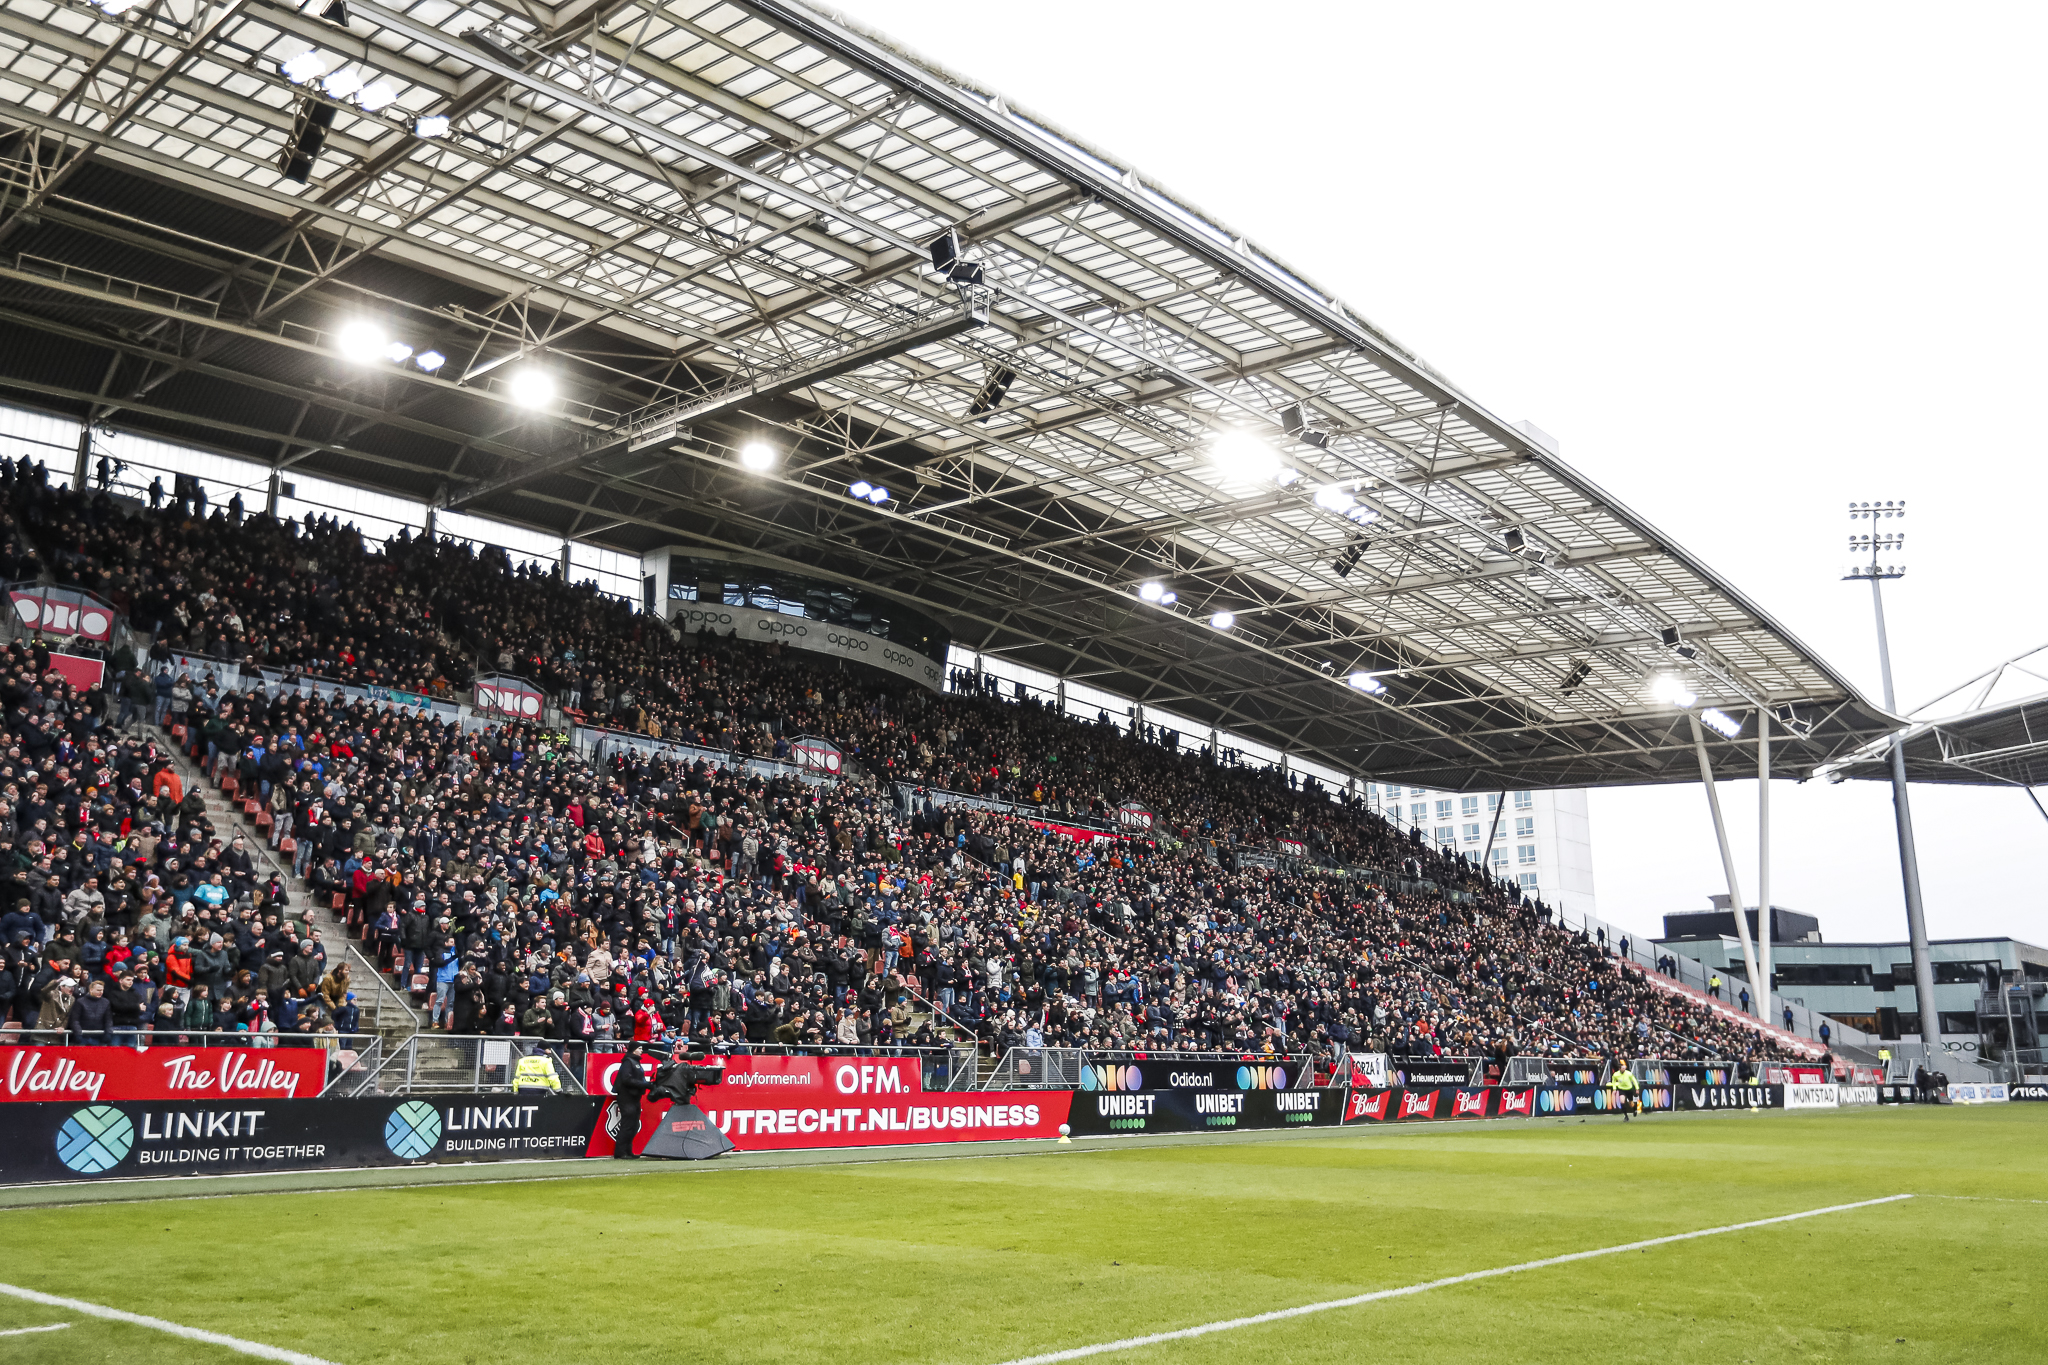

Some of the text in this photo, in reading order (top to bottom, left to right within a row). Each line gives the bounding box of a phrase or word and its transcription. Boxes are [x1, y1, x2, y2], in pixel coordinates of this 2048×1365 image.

[758, 619, 808, 637] oppo
[827, 633, 869, 651] oppo
[883, 648, 914, 667] oppo
[9, 1050, 106, 1101] Valley
[163, 1051, 300, 1099] The Valley
[1352, 1060, 1376, 1075] FORZA
[727, 1071, 811, 1088] onlyformen.nl
[1170, 1071, 1213, 1087] Odido.nl
[1098, 1094, 1156, 1116] UNIBET
[1195, 1093, 1244, 1113] UNIBET
[1276, 1092, 1320, 1111] UNIBET
[1352, 1093, 1380, 1115] Bud
[1404, 1092, 1430, 1114] Bud
[1456, 1090, 1482, 1112] Bud
[1502, 1090, 1526, 1110] Bud
[1710, 1087, 1772, 1107] CASTORE
[1792, 1088, 1835, 1104] MUNTSTAD
[143, 1110, 266, 1140] LINKIT
[447, 1105, 539, 1131] LINKIT
[662, 1104, 1040, 1135] UTRECHT.NL/BUSINESS
[446, 1135, 586, 1151] BUILDING IT TOGETHER
[139, 1144, 326, 1164] BUILDING IT TOGETHER
